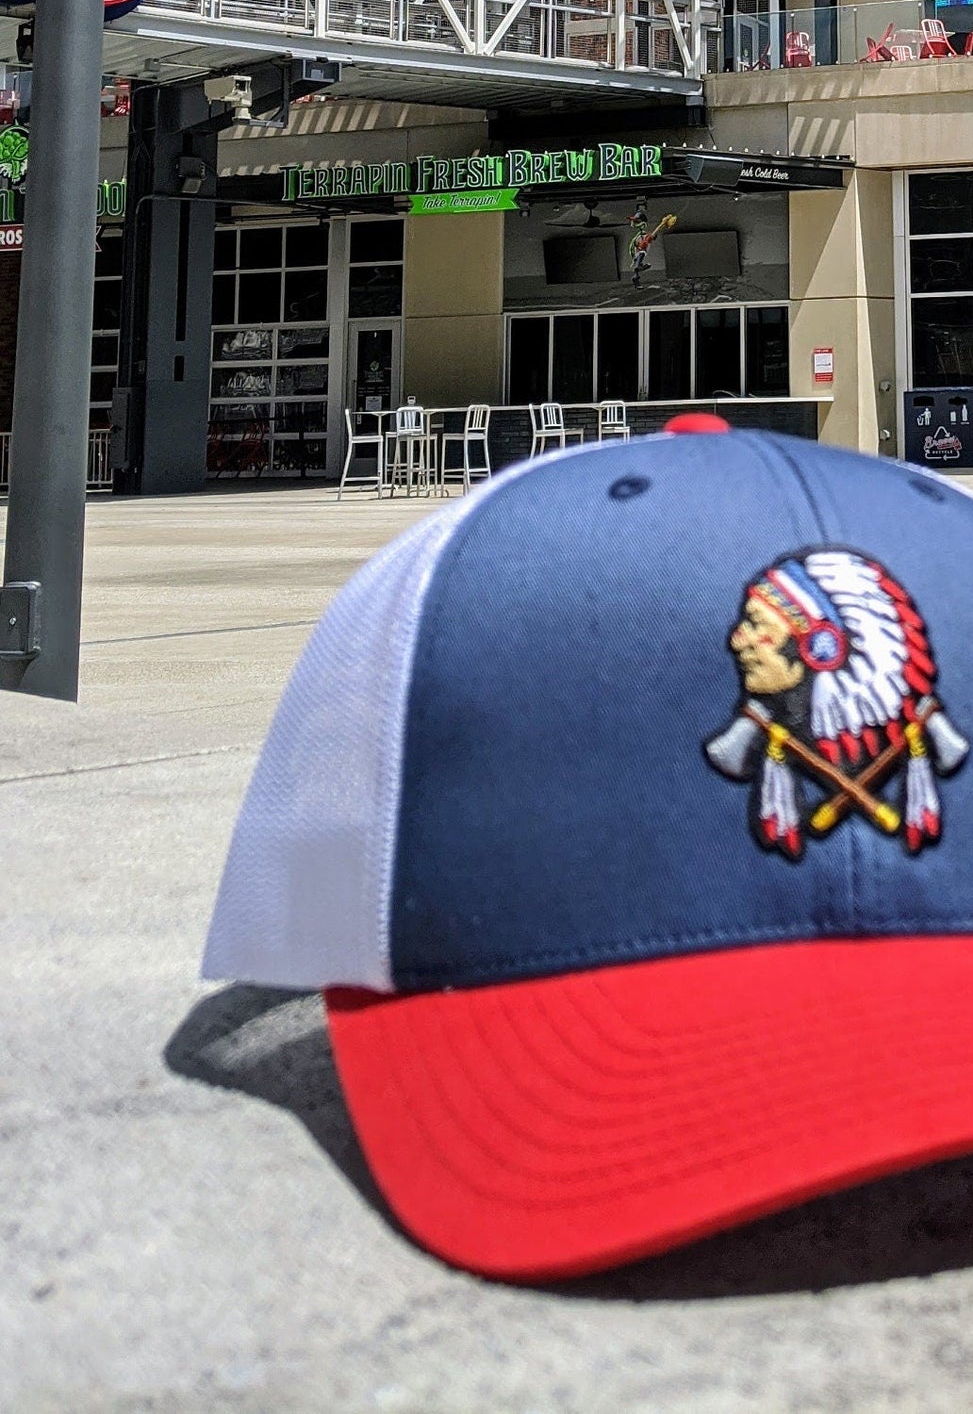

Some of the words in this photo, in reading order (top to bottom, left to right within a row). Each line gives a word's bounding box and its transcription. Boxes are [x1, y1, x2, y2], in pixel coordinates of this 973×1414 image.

[279, 161, 409, 201] TERRAPIN
[416, 155, 503, 193] FRESH
[508, 149, 592, 186] BREW
[598, 142, 664, 180] BAR
[740, 167, 754, 177] esh
[755, 167, 771, 179] Cold
[773, 168, 789, 180] Beer
[423, 196, 446, 210] Take
[450, 192, 501, 208] Terrapin!
